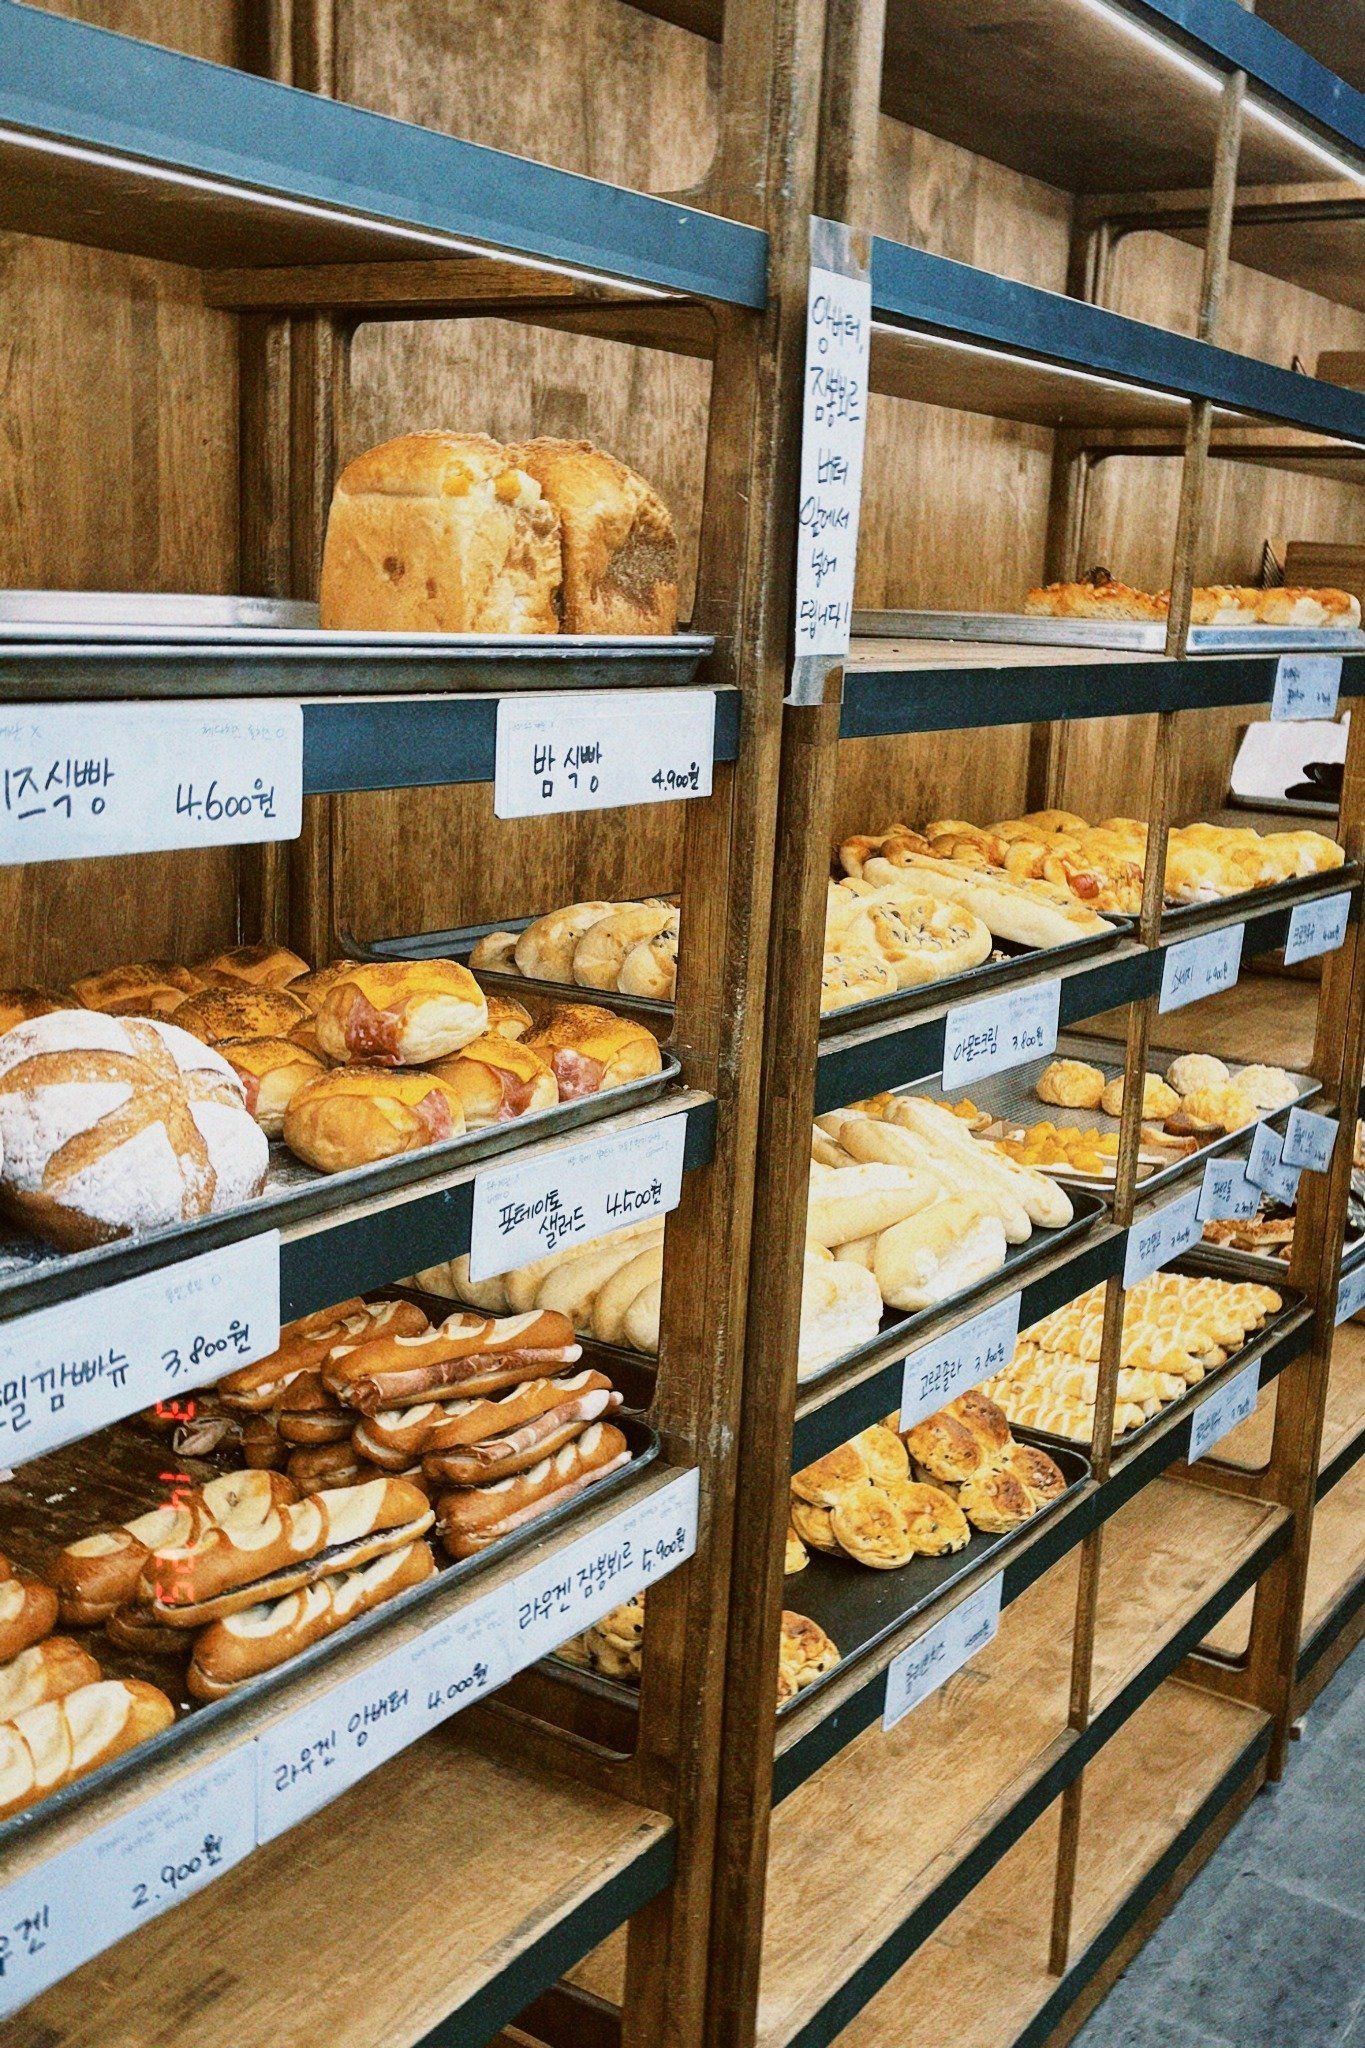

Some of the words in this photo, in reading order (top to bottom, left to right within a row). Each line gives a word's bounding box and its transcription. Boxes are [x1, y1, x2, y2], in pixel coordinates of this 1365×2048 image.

[3, 757, 115, 820] 즈식빵
[176, 778, 276, 821] 4.600원
[651, 761, 700, 792] 4.900원
[605, 1178, 662, 1218] 4.500원
[0, 1347, 129, 1432] 밀깜빠뉴
[161, 1320, 251, 1378] 3.800원
[347, 1688, 409, 1747] 앙버터
[131, 1833, 223, 1910] 2.900원
